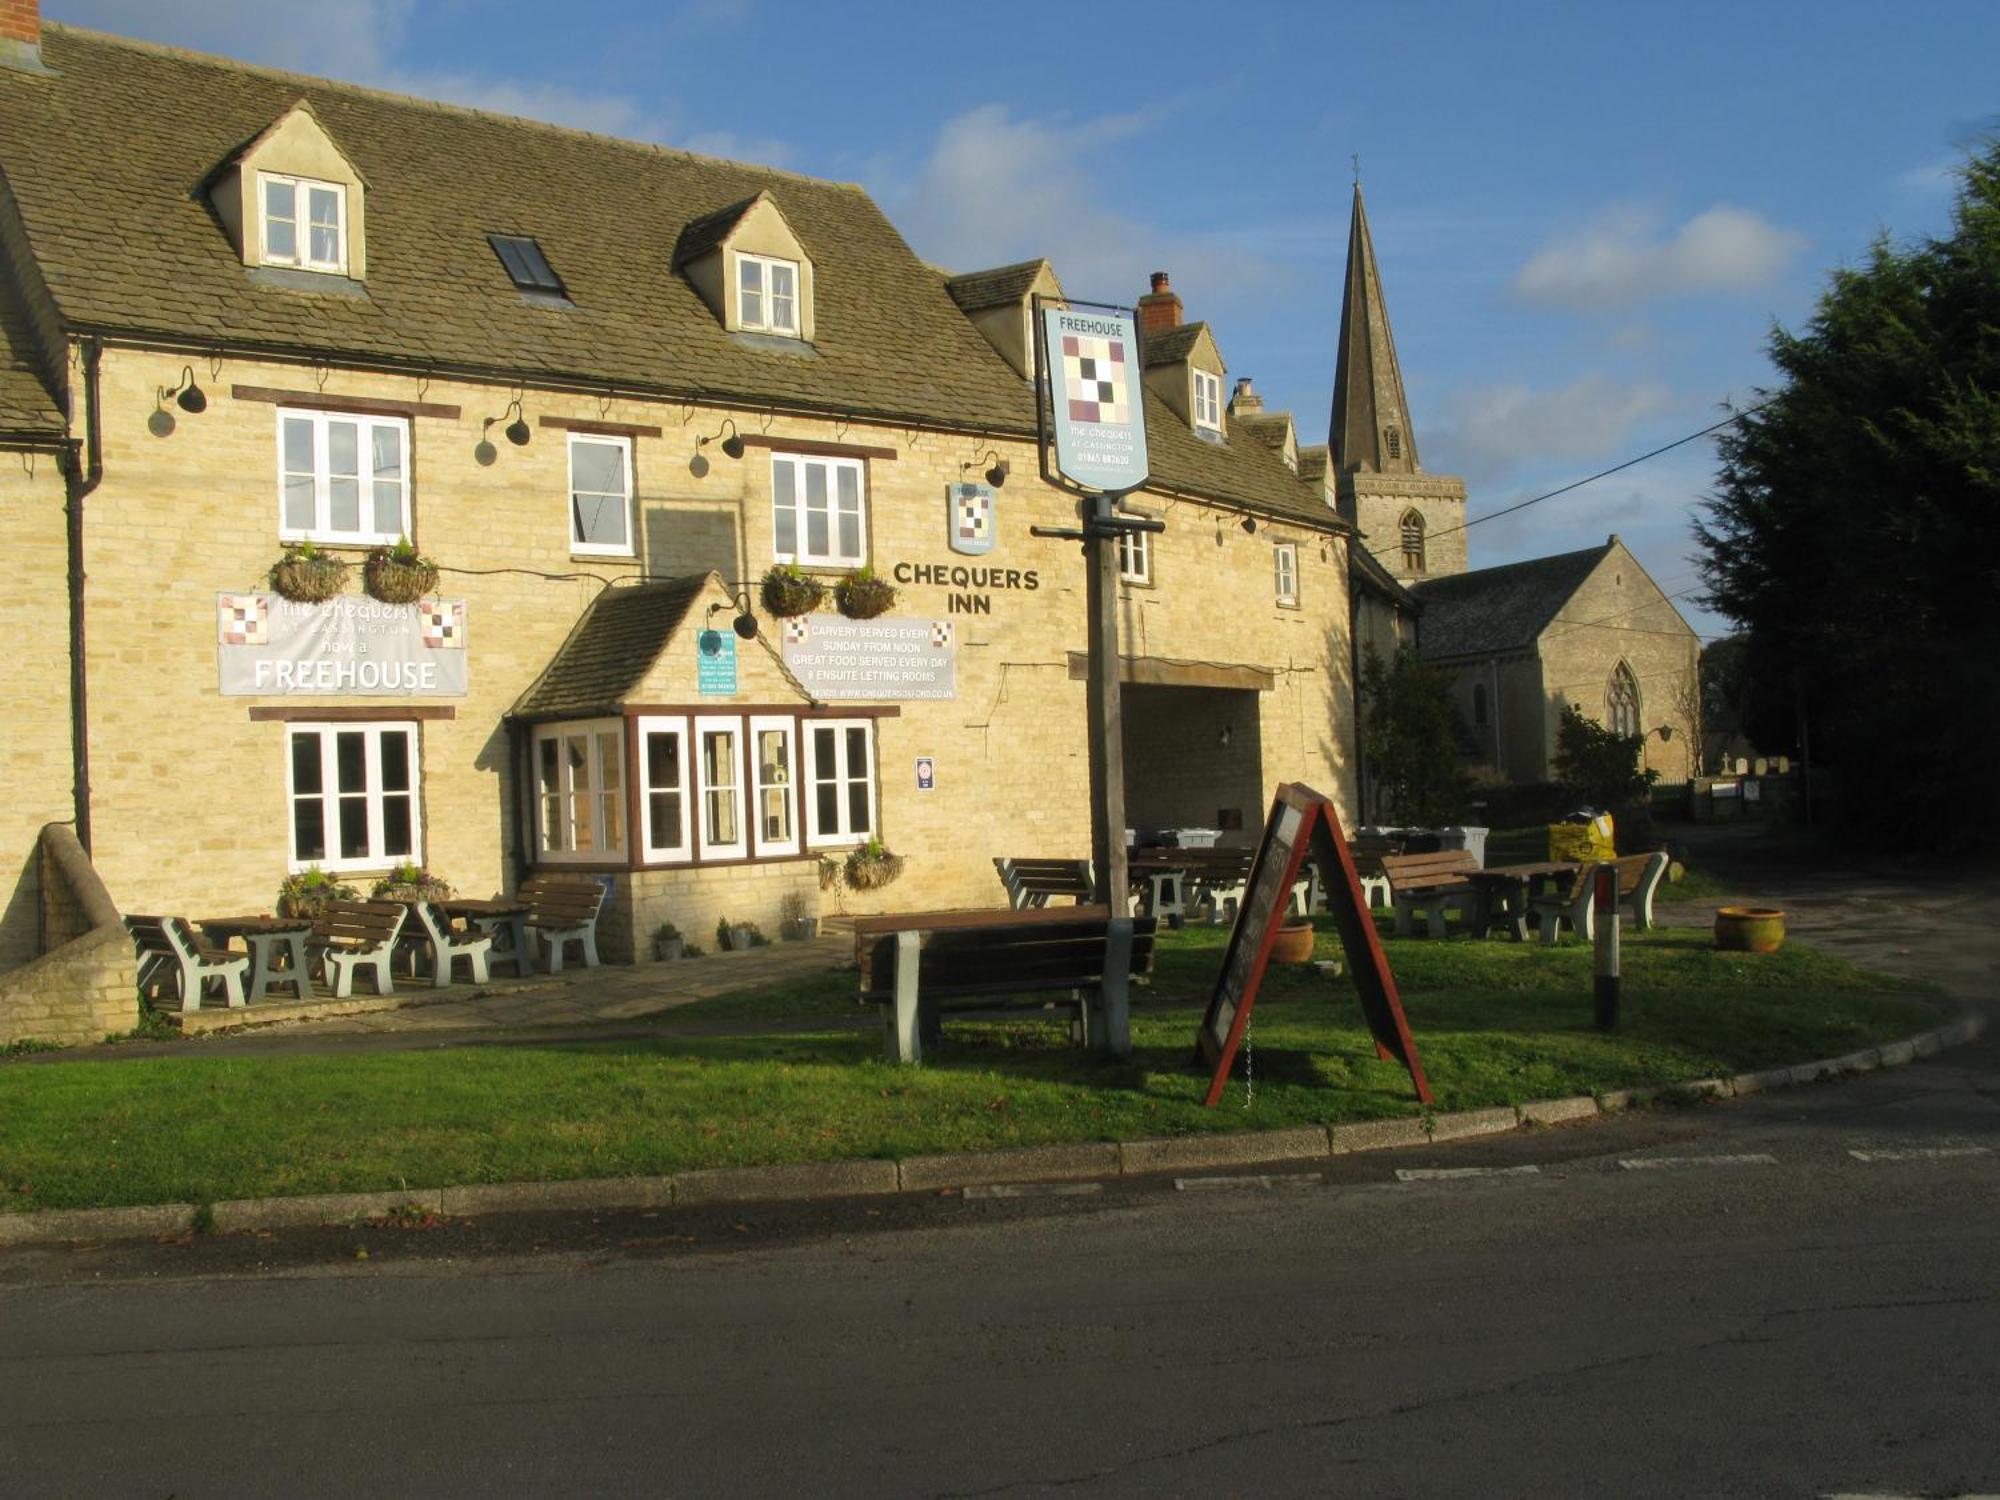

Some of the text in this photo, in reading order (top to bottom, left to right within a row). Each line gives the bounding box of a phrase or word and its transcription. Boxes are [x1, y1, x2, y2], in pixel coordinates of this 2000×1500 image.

[1060, 316, 1123, 337] FREEHOUSE
[894, 562, 1039, 590] CHEQUERS
[283, 600, 409, 623] the chequers
[948, 593, 990, 615] INN
[811, 625, 929, 639] CARVERY SERVED EVERY
[322, 638, 368, 654] now a
[823, 641, 921, 653] SUNDAY FROM NOON
[792, 654, 948, 668] GREAT FOOD SERVED EVERY DAY
[255, 659, 436, 689] FREEHOUSE
[817, 670, 858, 681] ENSUITE
[860, 671, 900, 681] LETTING
[902, 671, 937, 682] ROOMS
